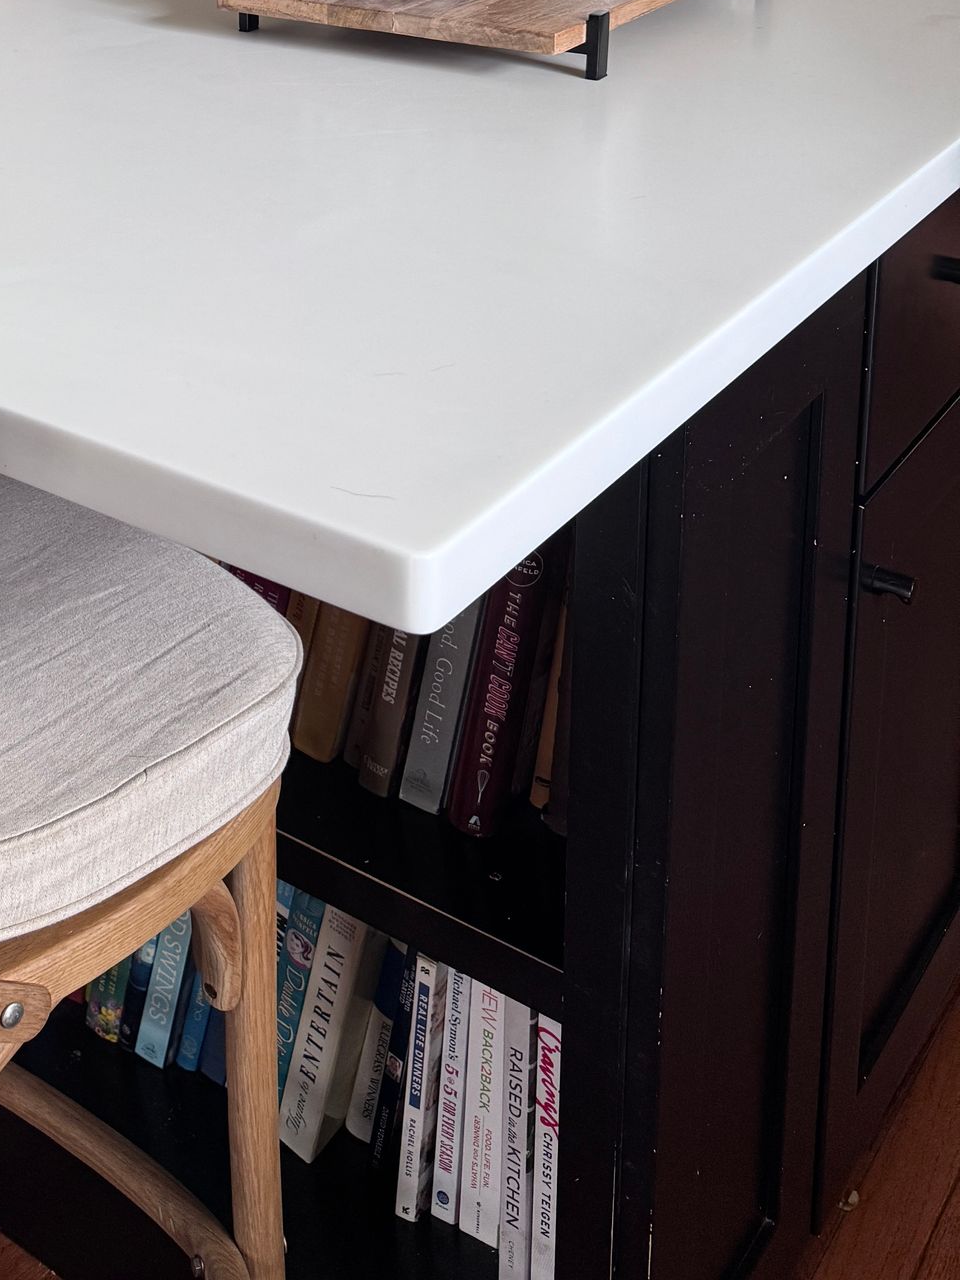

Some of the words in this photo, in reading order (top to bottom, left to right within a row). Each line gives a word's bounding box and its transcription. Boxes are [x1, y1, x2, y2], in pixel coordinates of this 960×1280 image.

[504, 591, 522, 627] THE
[493, 626, 520, 676] CAN'T
[382, 647, 405, 705] RECIPES
[428, 657, 453, 708] Good
[484, 674, 513, 721] COOK
[421, 709, 442, 745] Life
[480, 719, 500, 766] BOOK
[149, 935, 182, 1025] SWINGS
[279, 965, 305, 1017] Double
[300, 944, 345, 1084] ENTERTAIN
[417, 995, 428, 1022] REAL
[374, 1023, 393, 1075] BLUEGRASS
[415, 1023, 425, 1047] LIFE
[448, 1014, 461, 1061] Symon's
[411, 1048, 424, 1097] DINNERS
[443, 1084, 458, 1098] 5
[444, 1063, 459, 1078] 5
[479, 1028, 494, 1113] BACK2BACK
[508, 1046, 524, 1118] RAISED
[536, 1026, 561, 1140] Cravings
[361, 1076, 380, 1122] WINNERS
[442, 1098, 457, 1117] FOR
[509, 1117, 517, 1128] in
[407, 1118, 416, 1147] RACHEL
[440, 1115, 456, 1143] EVERY
[507, 1128, 518, 1144] the
[404, 1149, 413, 1178] HOLLIS
[438, 1141, 454, 1174] SEASON
[541, 1132, 553, 1190] CHRISSY
[506, 1146, 522, 1230] KITCHEN
[540, 1192, 552, 1238] TEIGEN
